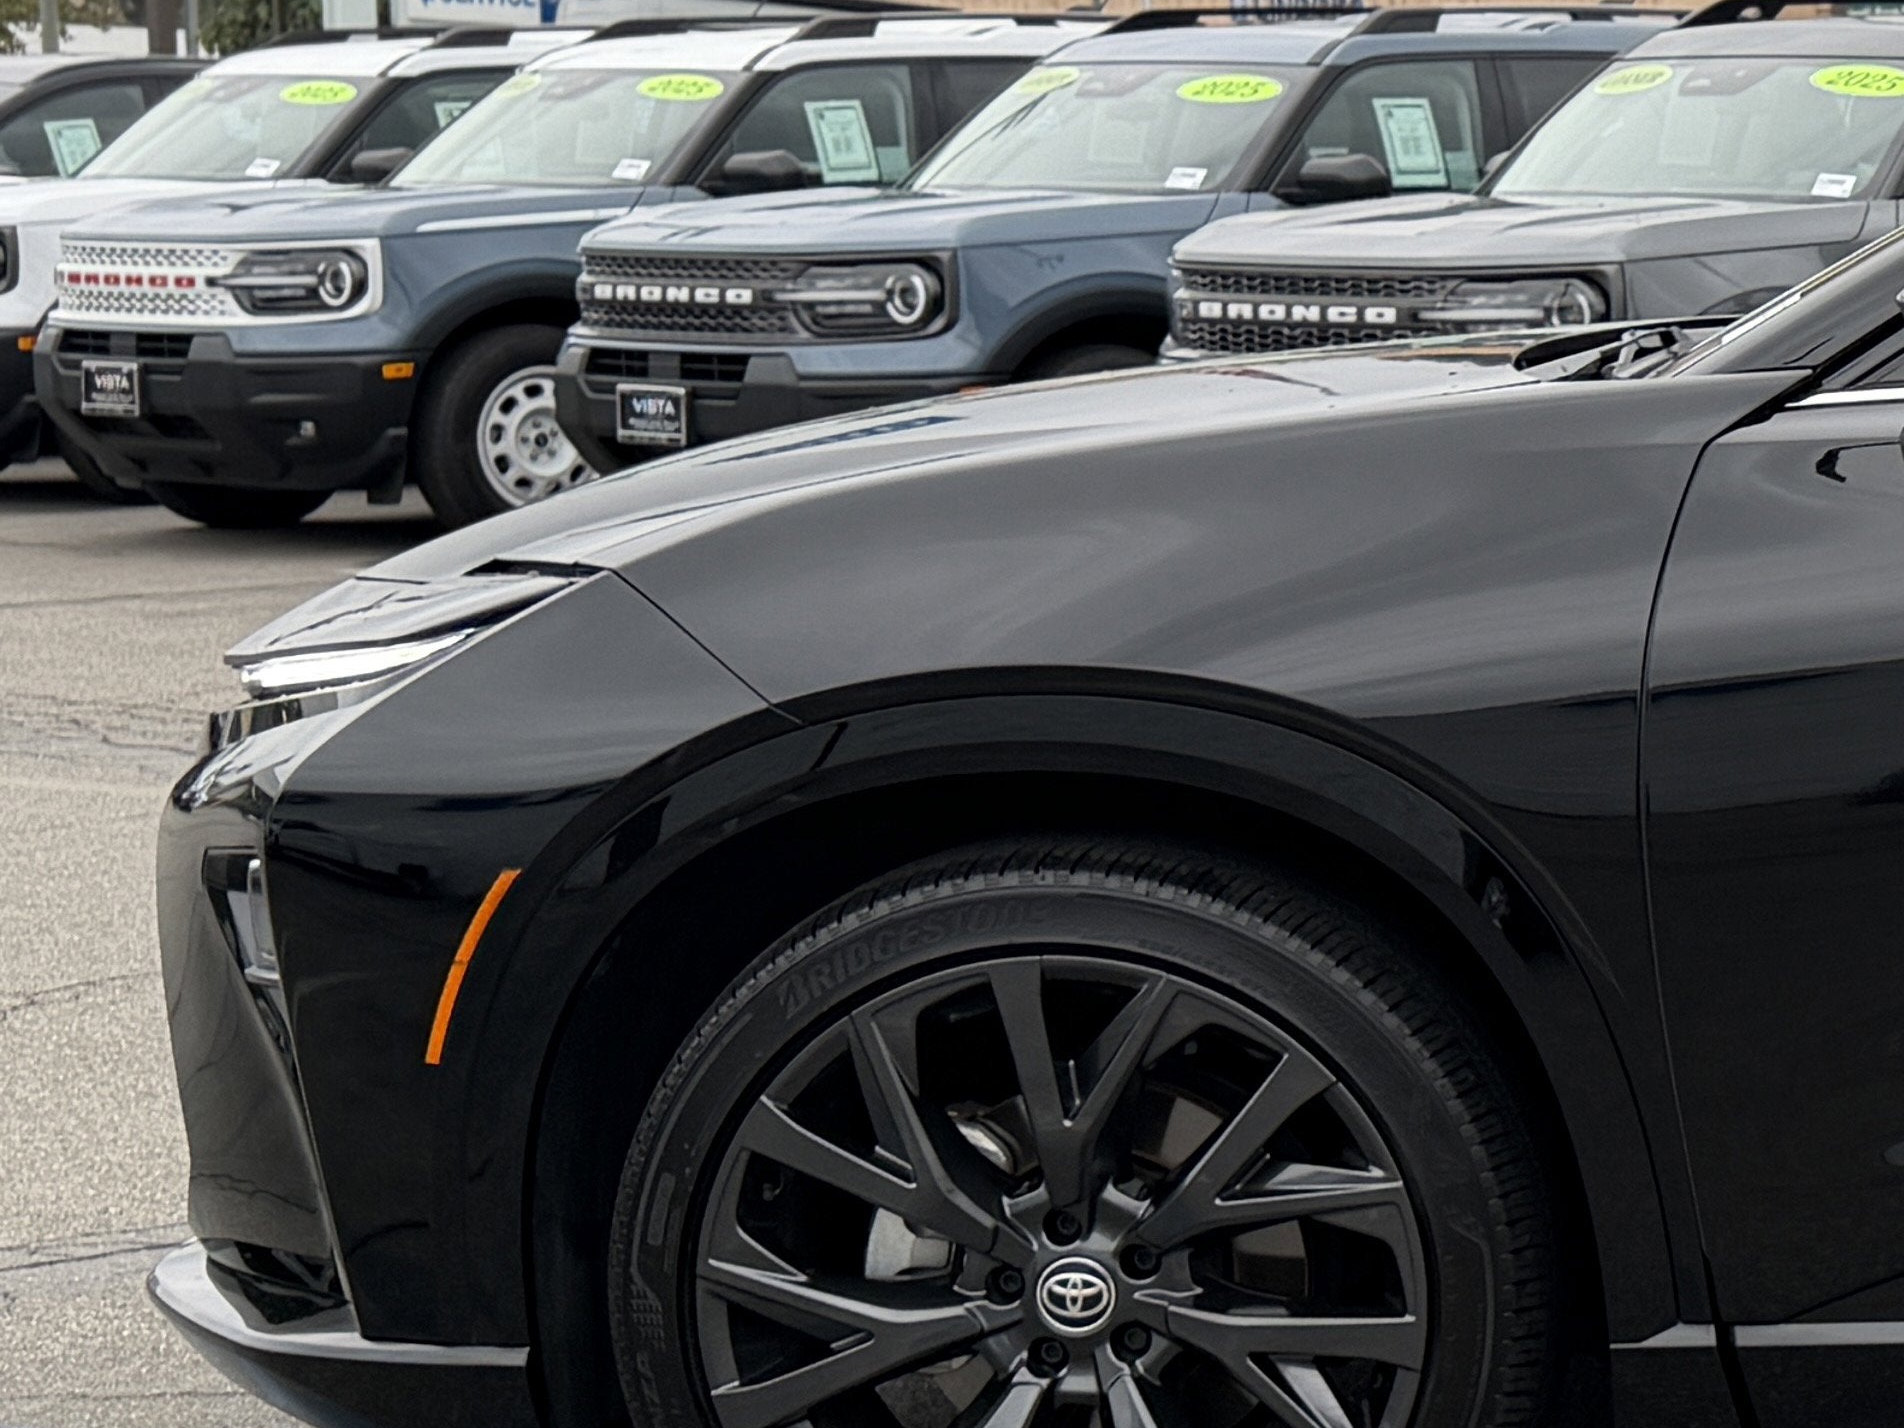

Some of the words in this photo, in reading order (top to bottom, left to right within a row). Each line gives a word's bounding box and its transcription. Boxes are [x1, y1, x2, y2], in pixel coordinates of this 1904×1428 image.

[67, 272, 196, 288] BRONCO
[593, 283, 753, 305] BRONCO
[1198, 300, 1398, 324] BRONCO
[778, 896, 1053, 1020] BRIDGESTONE
